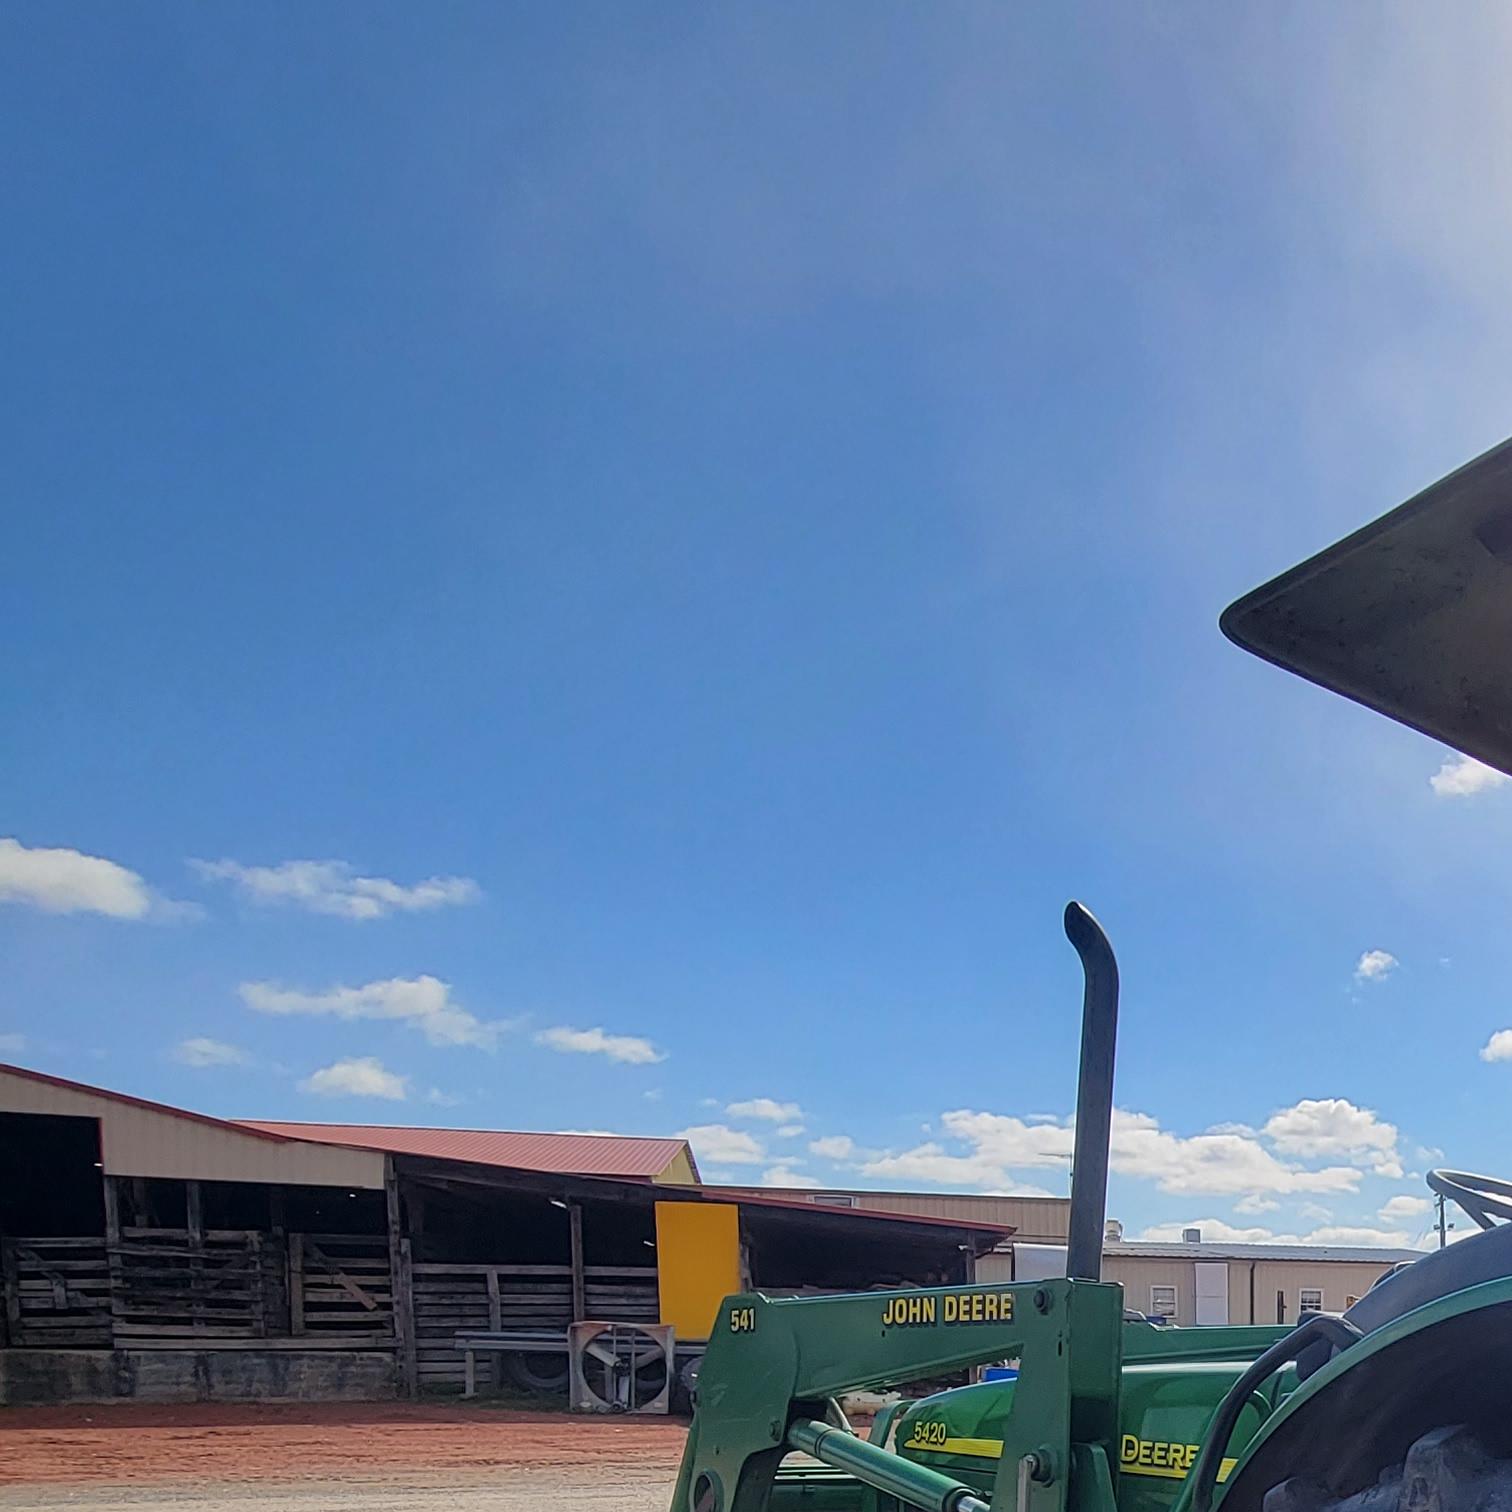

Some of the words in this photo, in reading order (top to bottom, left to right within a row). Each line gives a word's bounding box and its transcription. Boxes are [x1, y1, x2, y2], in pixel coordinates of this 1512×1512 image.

[730, 1307, 755, 1333] 541
[882, 1296, 936, 1325] JOHN
[944, 1293, 1013, 1323] DEERE
[913, 1420, 947, 1445] 5420
[1120, 1433, 1201, 1468] DEERE
